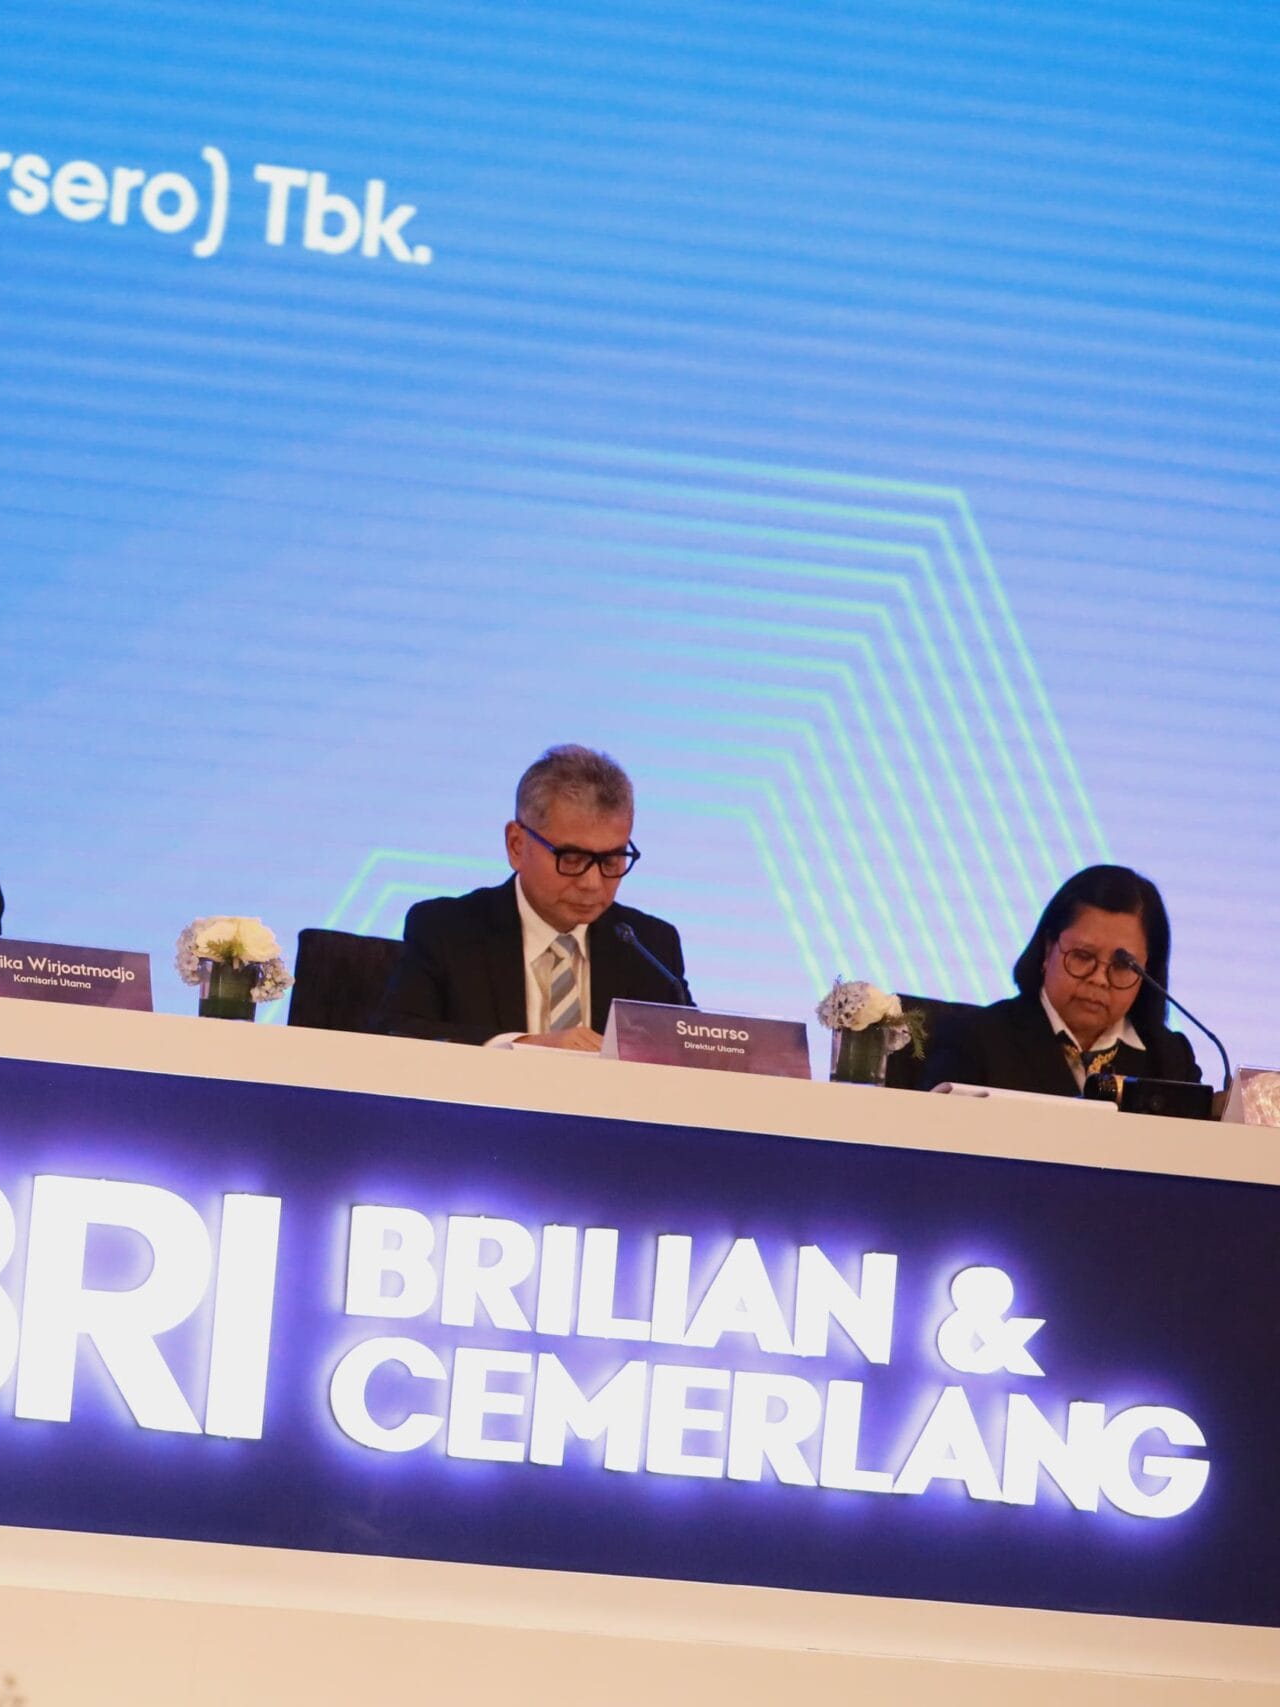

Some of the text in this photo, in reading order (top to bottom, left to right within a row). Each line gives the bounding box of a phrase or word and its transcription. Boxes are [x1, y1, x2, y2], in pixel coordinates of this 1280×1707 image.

[253, 163, 434, 266] Tbk.
[13, 974, 92, 989] Komisaris Utama
[27, 955, 135, 983] Wirjoatmodjo
[676, 1020, 749, 1041] Sunarso
[684, 1041, 745, 1054] Direktur Utama
[345, 1204, 1046, 1376] BRILIAN &
[330, 1336, 1211, 1519] CEMERLANG
